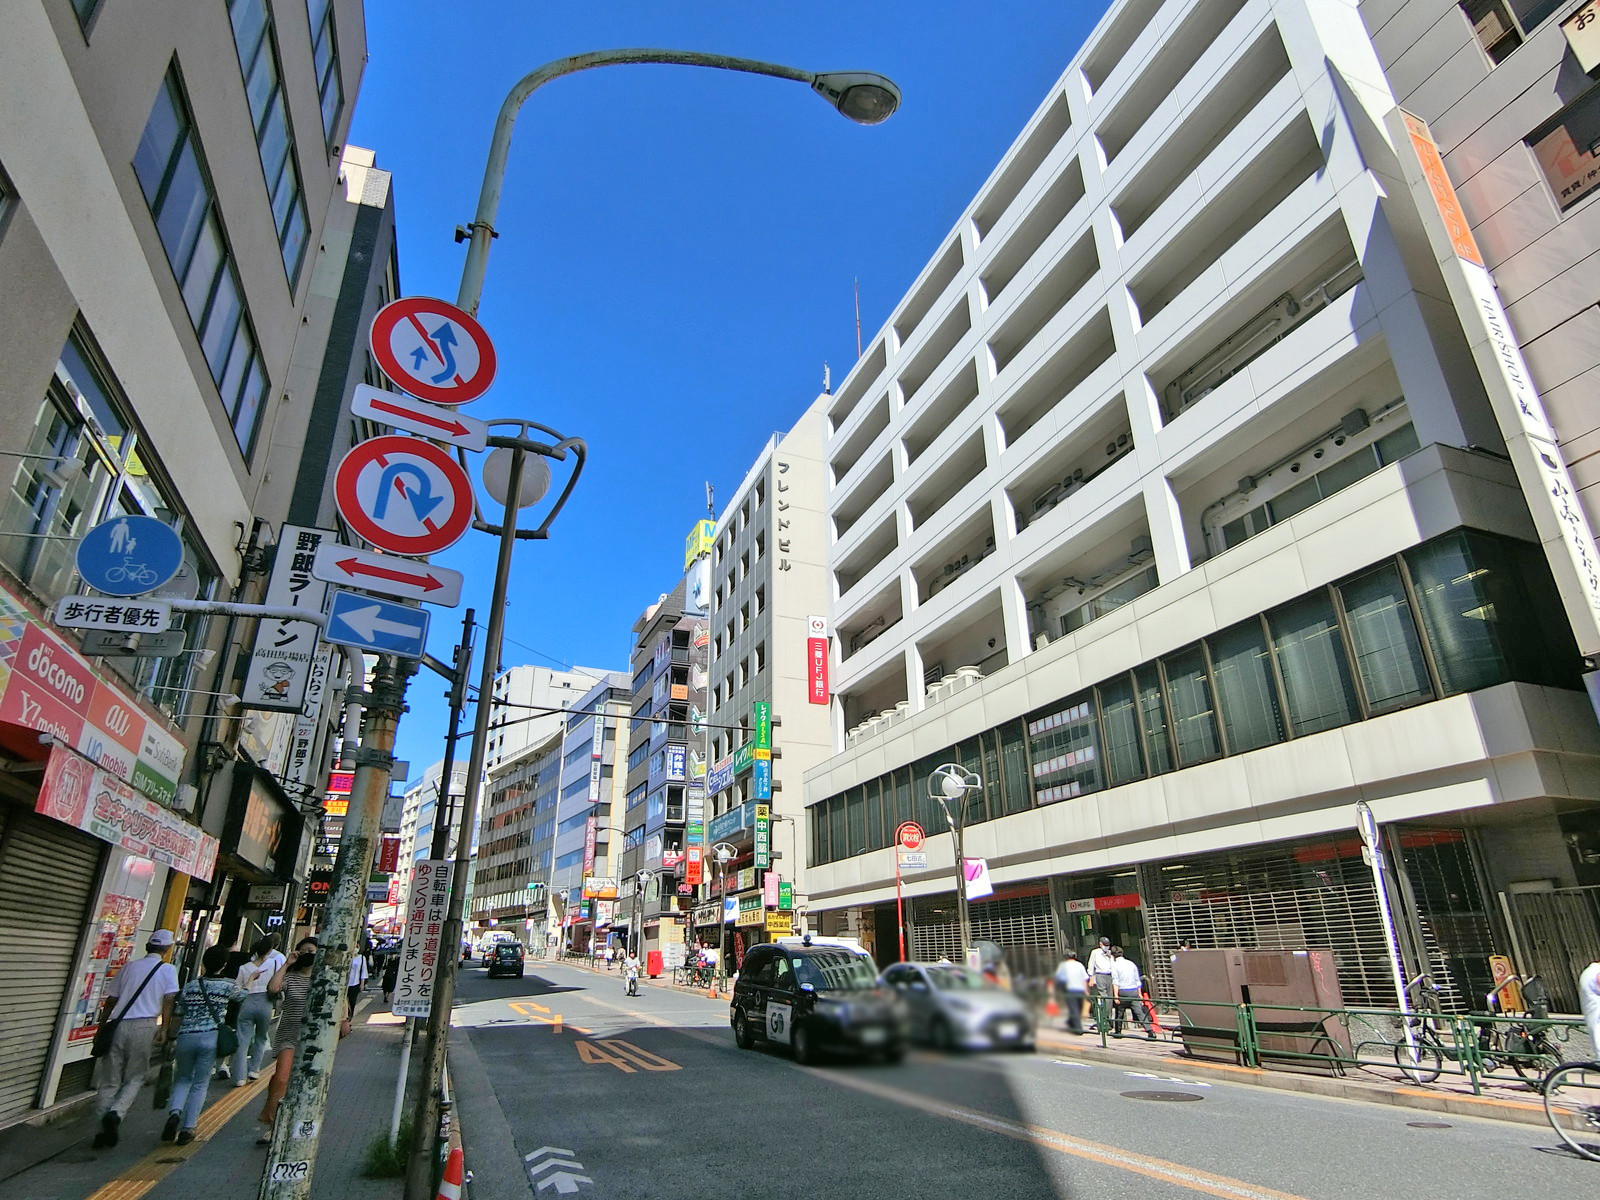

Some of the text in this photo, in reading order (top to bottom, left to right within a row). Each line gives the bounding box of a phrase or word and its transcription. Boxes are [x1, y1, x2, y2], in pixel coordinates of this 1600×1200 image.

[1574, 8, 1597, 31] お
[1480, 296, 1526, 391] HAIR SHOP
[777, 461, 792, 573] フレンドビル
[273, 530, 323, 648] 野郎ラーン
[63, 602, 161, 628] 歩行者優先
[27, 642, 85, 705] docomo
[254, 648, 310, 664] 高田馬場店
[814, 641, 825, 698] 三菱UFJ銀行
[104, 704, 131, 738] au
[86, 736, 128, 779] UQ mobile
[153, 740, 178, 773] SoftBank
[585, 818, 596, 867] ツルハドラッグ
[757, 820, 768, 865] 中西薬局
[902, 832, 920, 843] 消火栓
[1077, 901, 1091, 909] MUFG
[399, 863, 433, 998] ゆっくり通行しましょう
[416, 864, 449, 998] 自転車は車道寄りを
[770, 1011, 785, 1034] GO
[574, 1039, 684, 1074] 40
